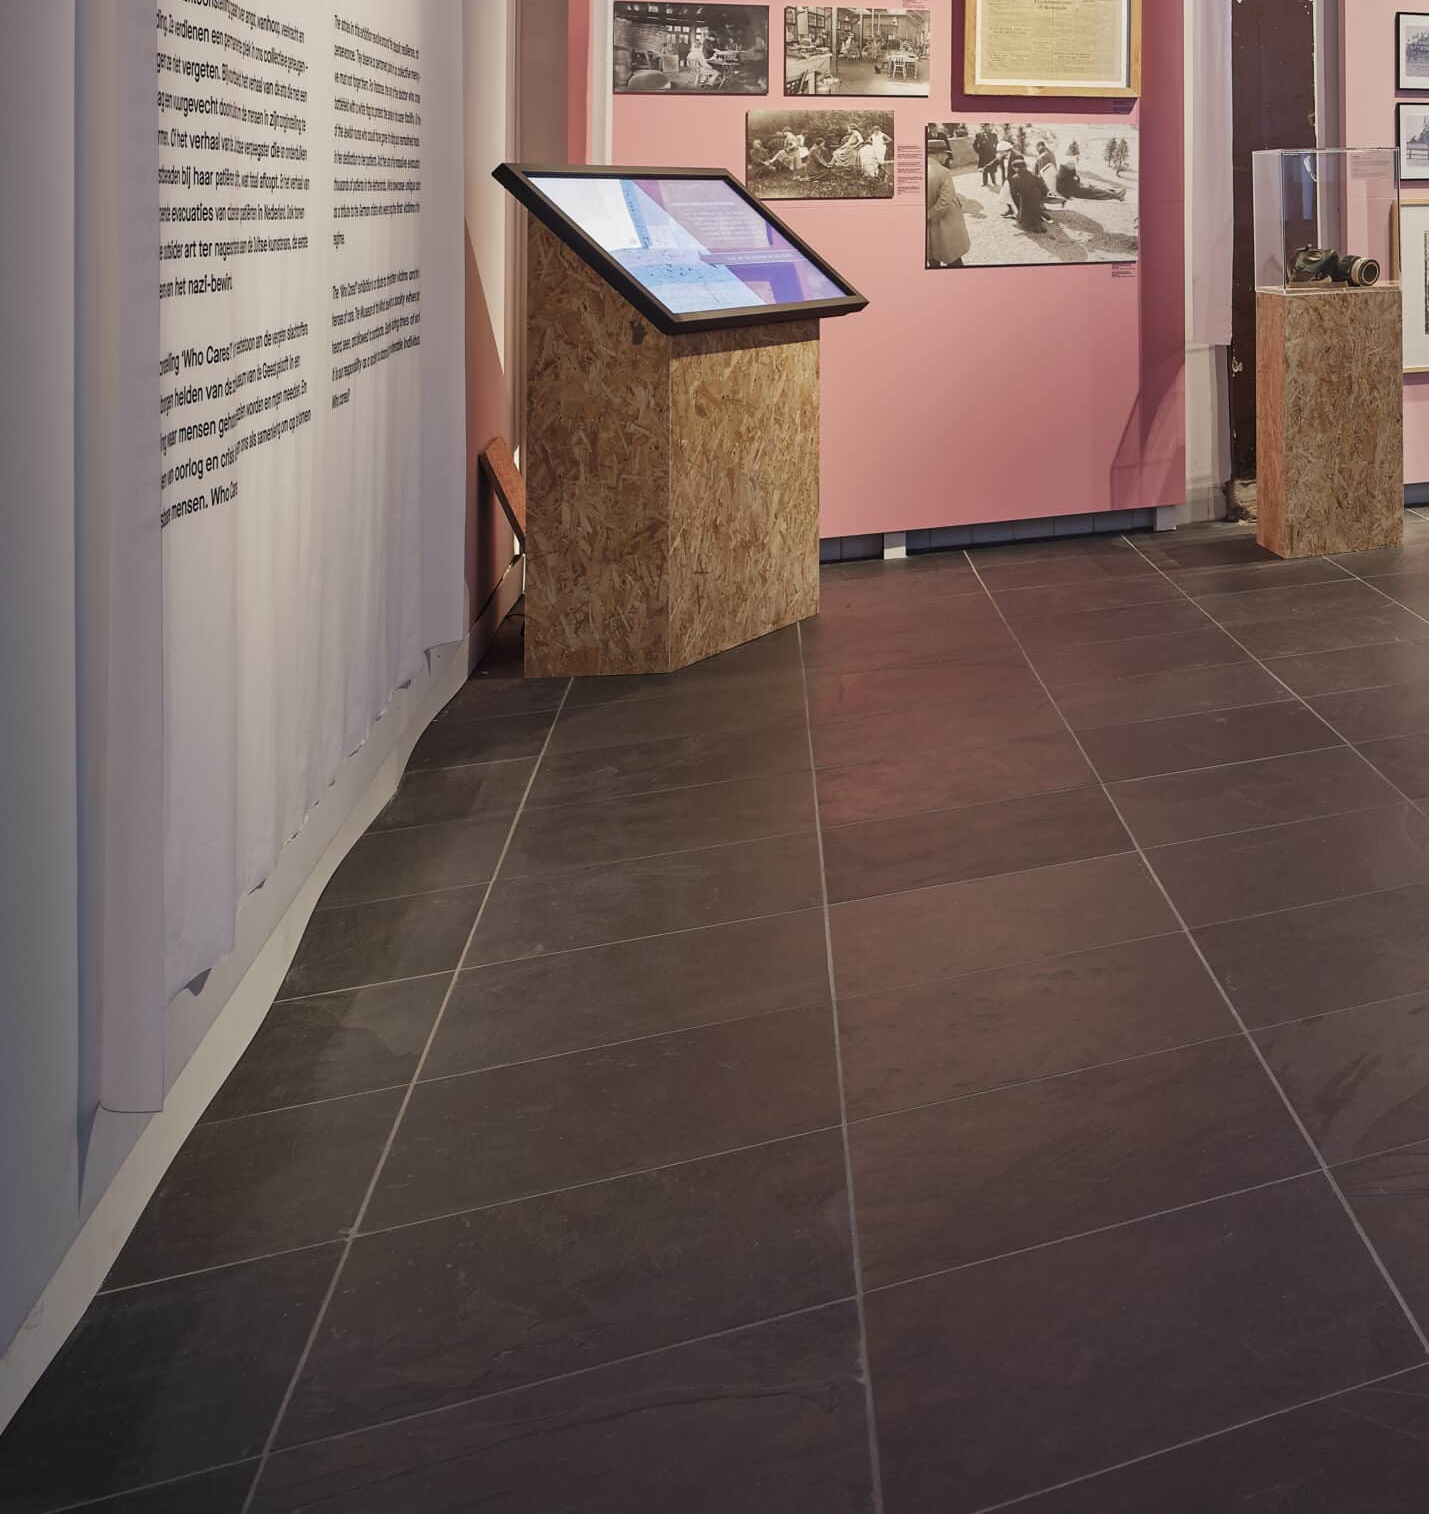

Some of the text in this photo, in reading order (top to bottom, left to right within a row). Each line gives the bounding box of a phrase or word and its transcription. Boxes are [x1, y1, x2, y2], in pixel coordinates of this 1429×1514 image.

[211, 28, 224, 46] een
[182, 59, 221, 82] vergeten.
[176, 129, 188, 148] het
[189, 131, 220, 150] verhaal
[182, 166, 213, 189] bij haar
[171, 203, 214, 222] evacuaties
[184, 240, 213, 258] art ter
[175, 277, 186, 296] het
[175, 385, 203, 408] helden
[205, 383, 223, 399] van
[179, 420, 216, 443] mensen
[175, 458, 203, 481] oorlog
[206, 455, 219, 471] en
[171, 485, 229, 521] mensen. Who
